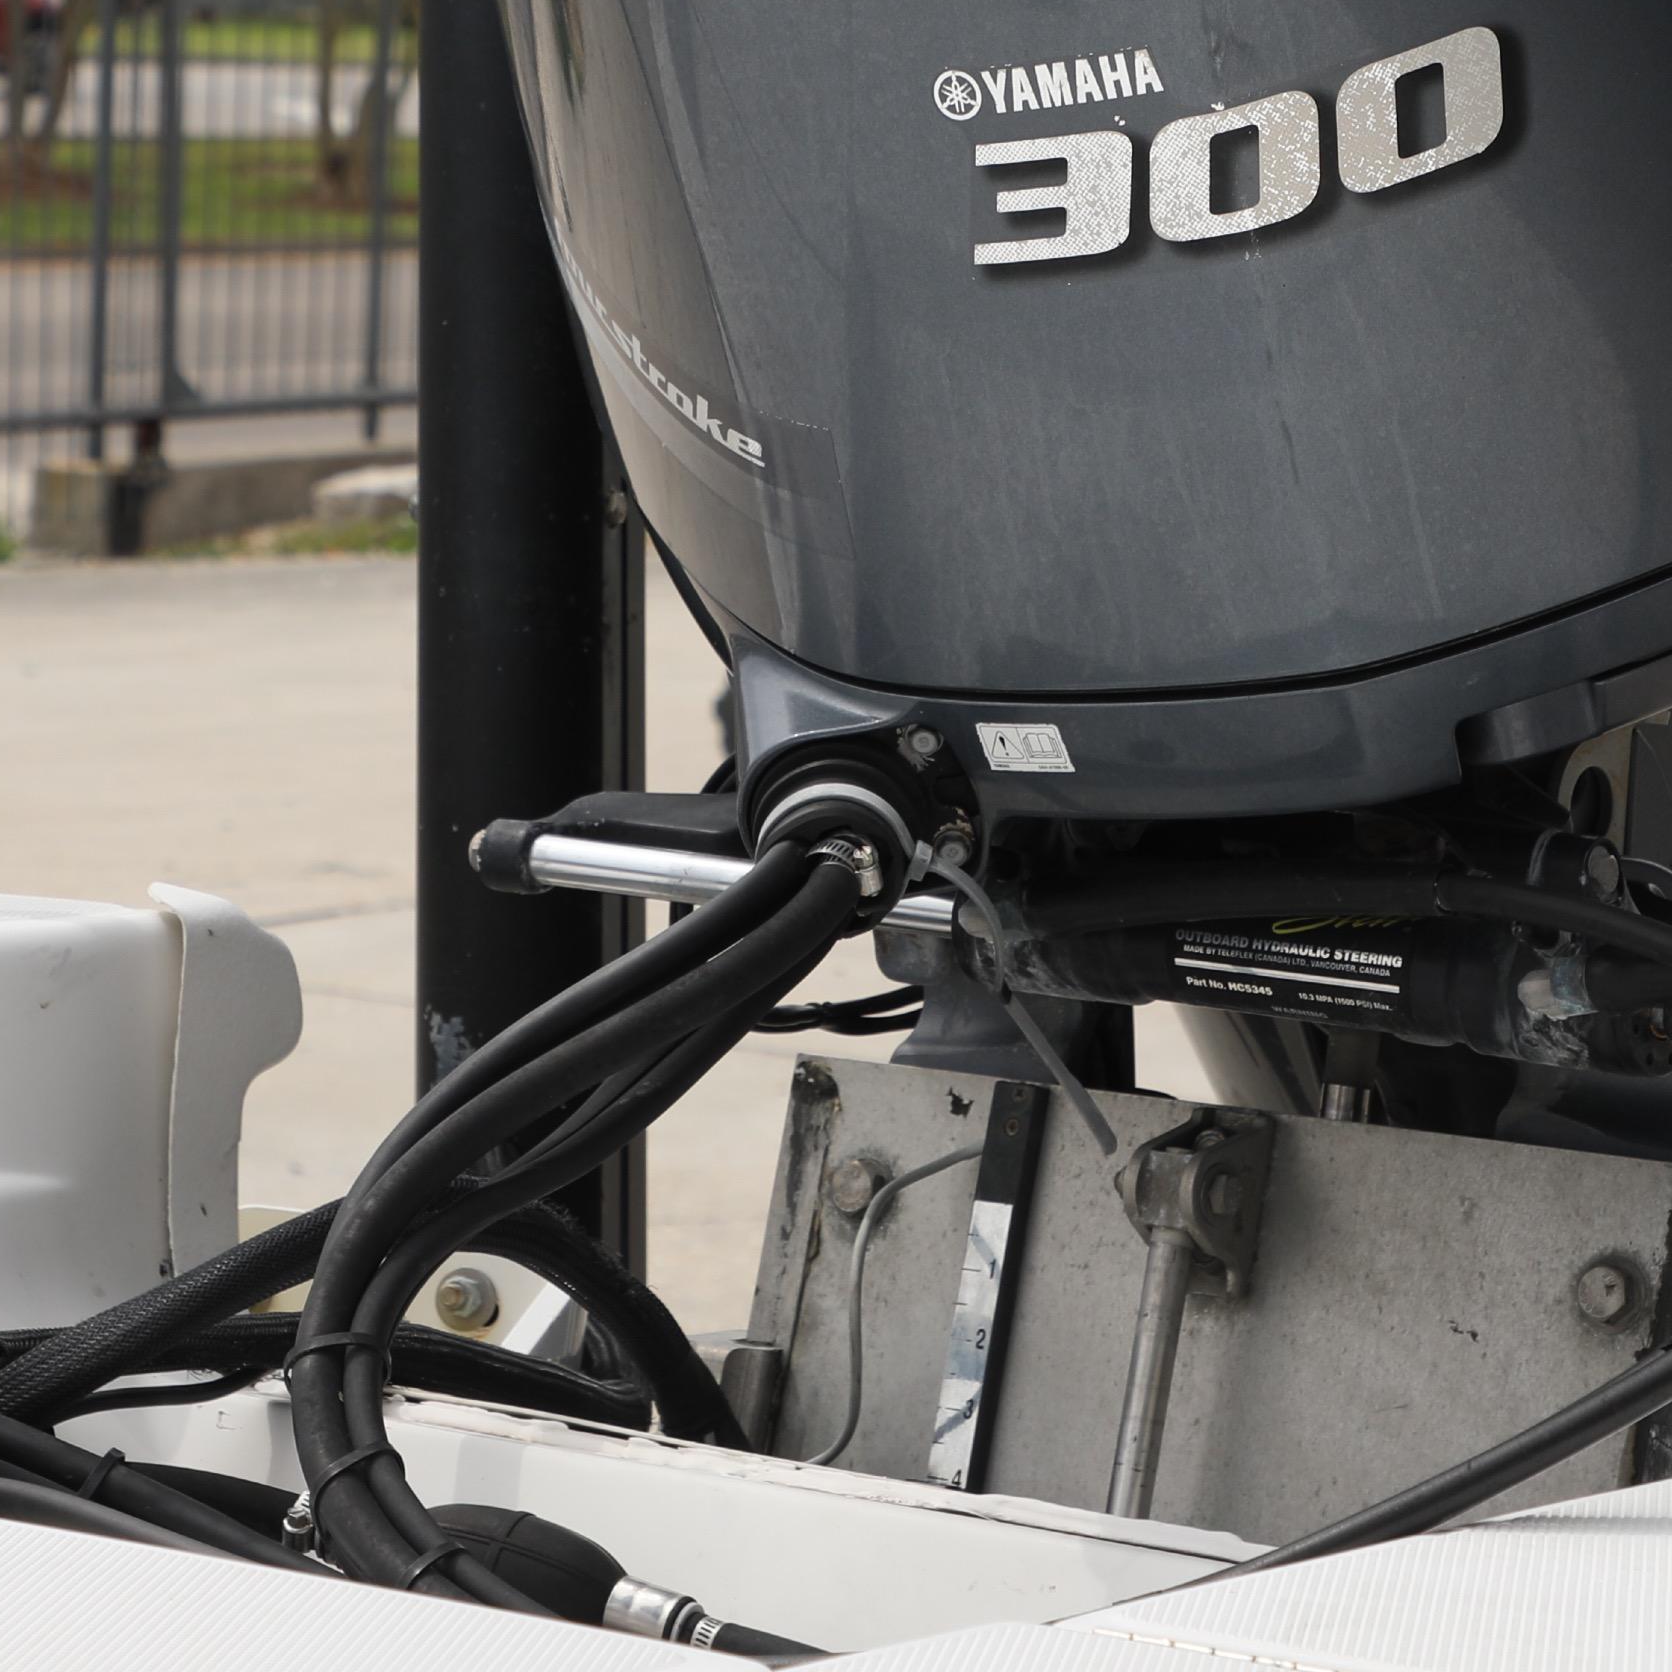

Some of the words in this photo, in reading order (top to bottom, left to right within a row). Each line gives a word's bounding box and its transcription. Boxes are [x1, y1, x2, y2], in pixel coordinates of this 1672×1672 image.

[981, 47, 1164, 115] YAMAHA
[974, 26, 1504, 265] 300
[609, 318, 765, 468] stroke
[1176, 929, 1249, 948] OUTBOARD
[1252, 937, 1331, 959] HYDRAULIC
[1333, 948, 1403, 968] STEERING
[1183, 944, 1204, 954] MADE
[1217, 948, 1253, 960] TELEFLEX
[1254, 952, 1290, 965] (CANADA)
[1359, 966, 1391, 977] CANADA
[1185, 976, 1208, 987] Part
[1208, 979, 1227, 990] No.
[1227, 981, 1273, 996] HC5345
[989, 1258, 997, 1280] 1
[975, 1328, 986, 1350] 2
[963, 1398, 974, 1420] 3
[951, 1469, 962, 1486] 4
